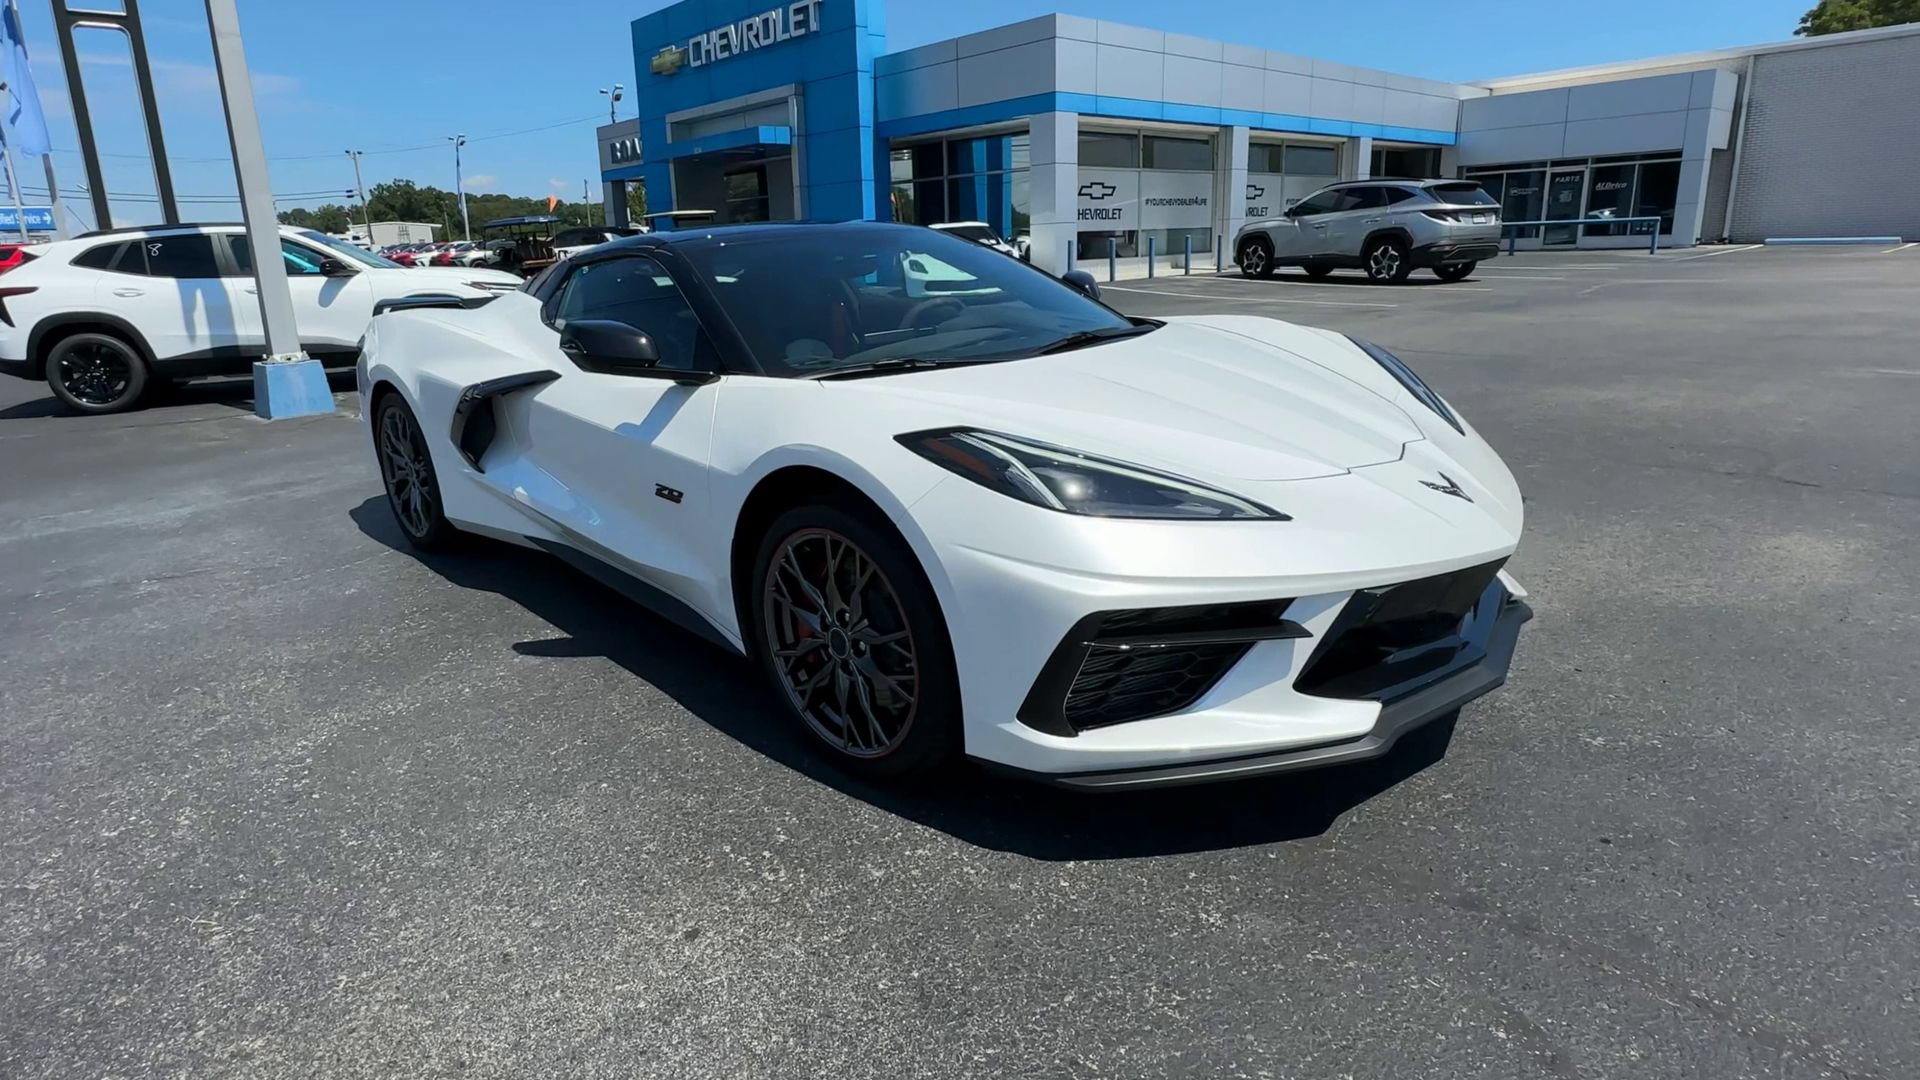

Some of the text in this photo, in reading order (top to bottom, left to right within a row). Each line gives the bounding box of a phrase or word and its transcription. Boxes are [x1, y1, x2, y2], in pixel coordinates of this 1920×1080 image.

[688, 0, 824, 68] CHEVROLET
[1554, 175, 1580, 183] PARTS
[1077, 208, 1122, 220] HEVROLET
